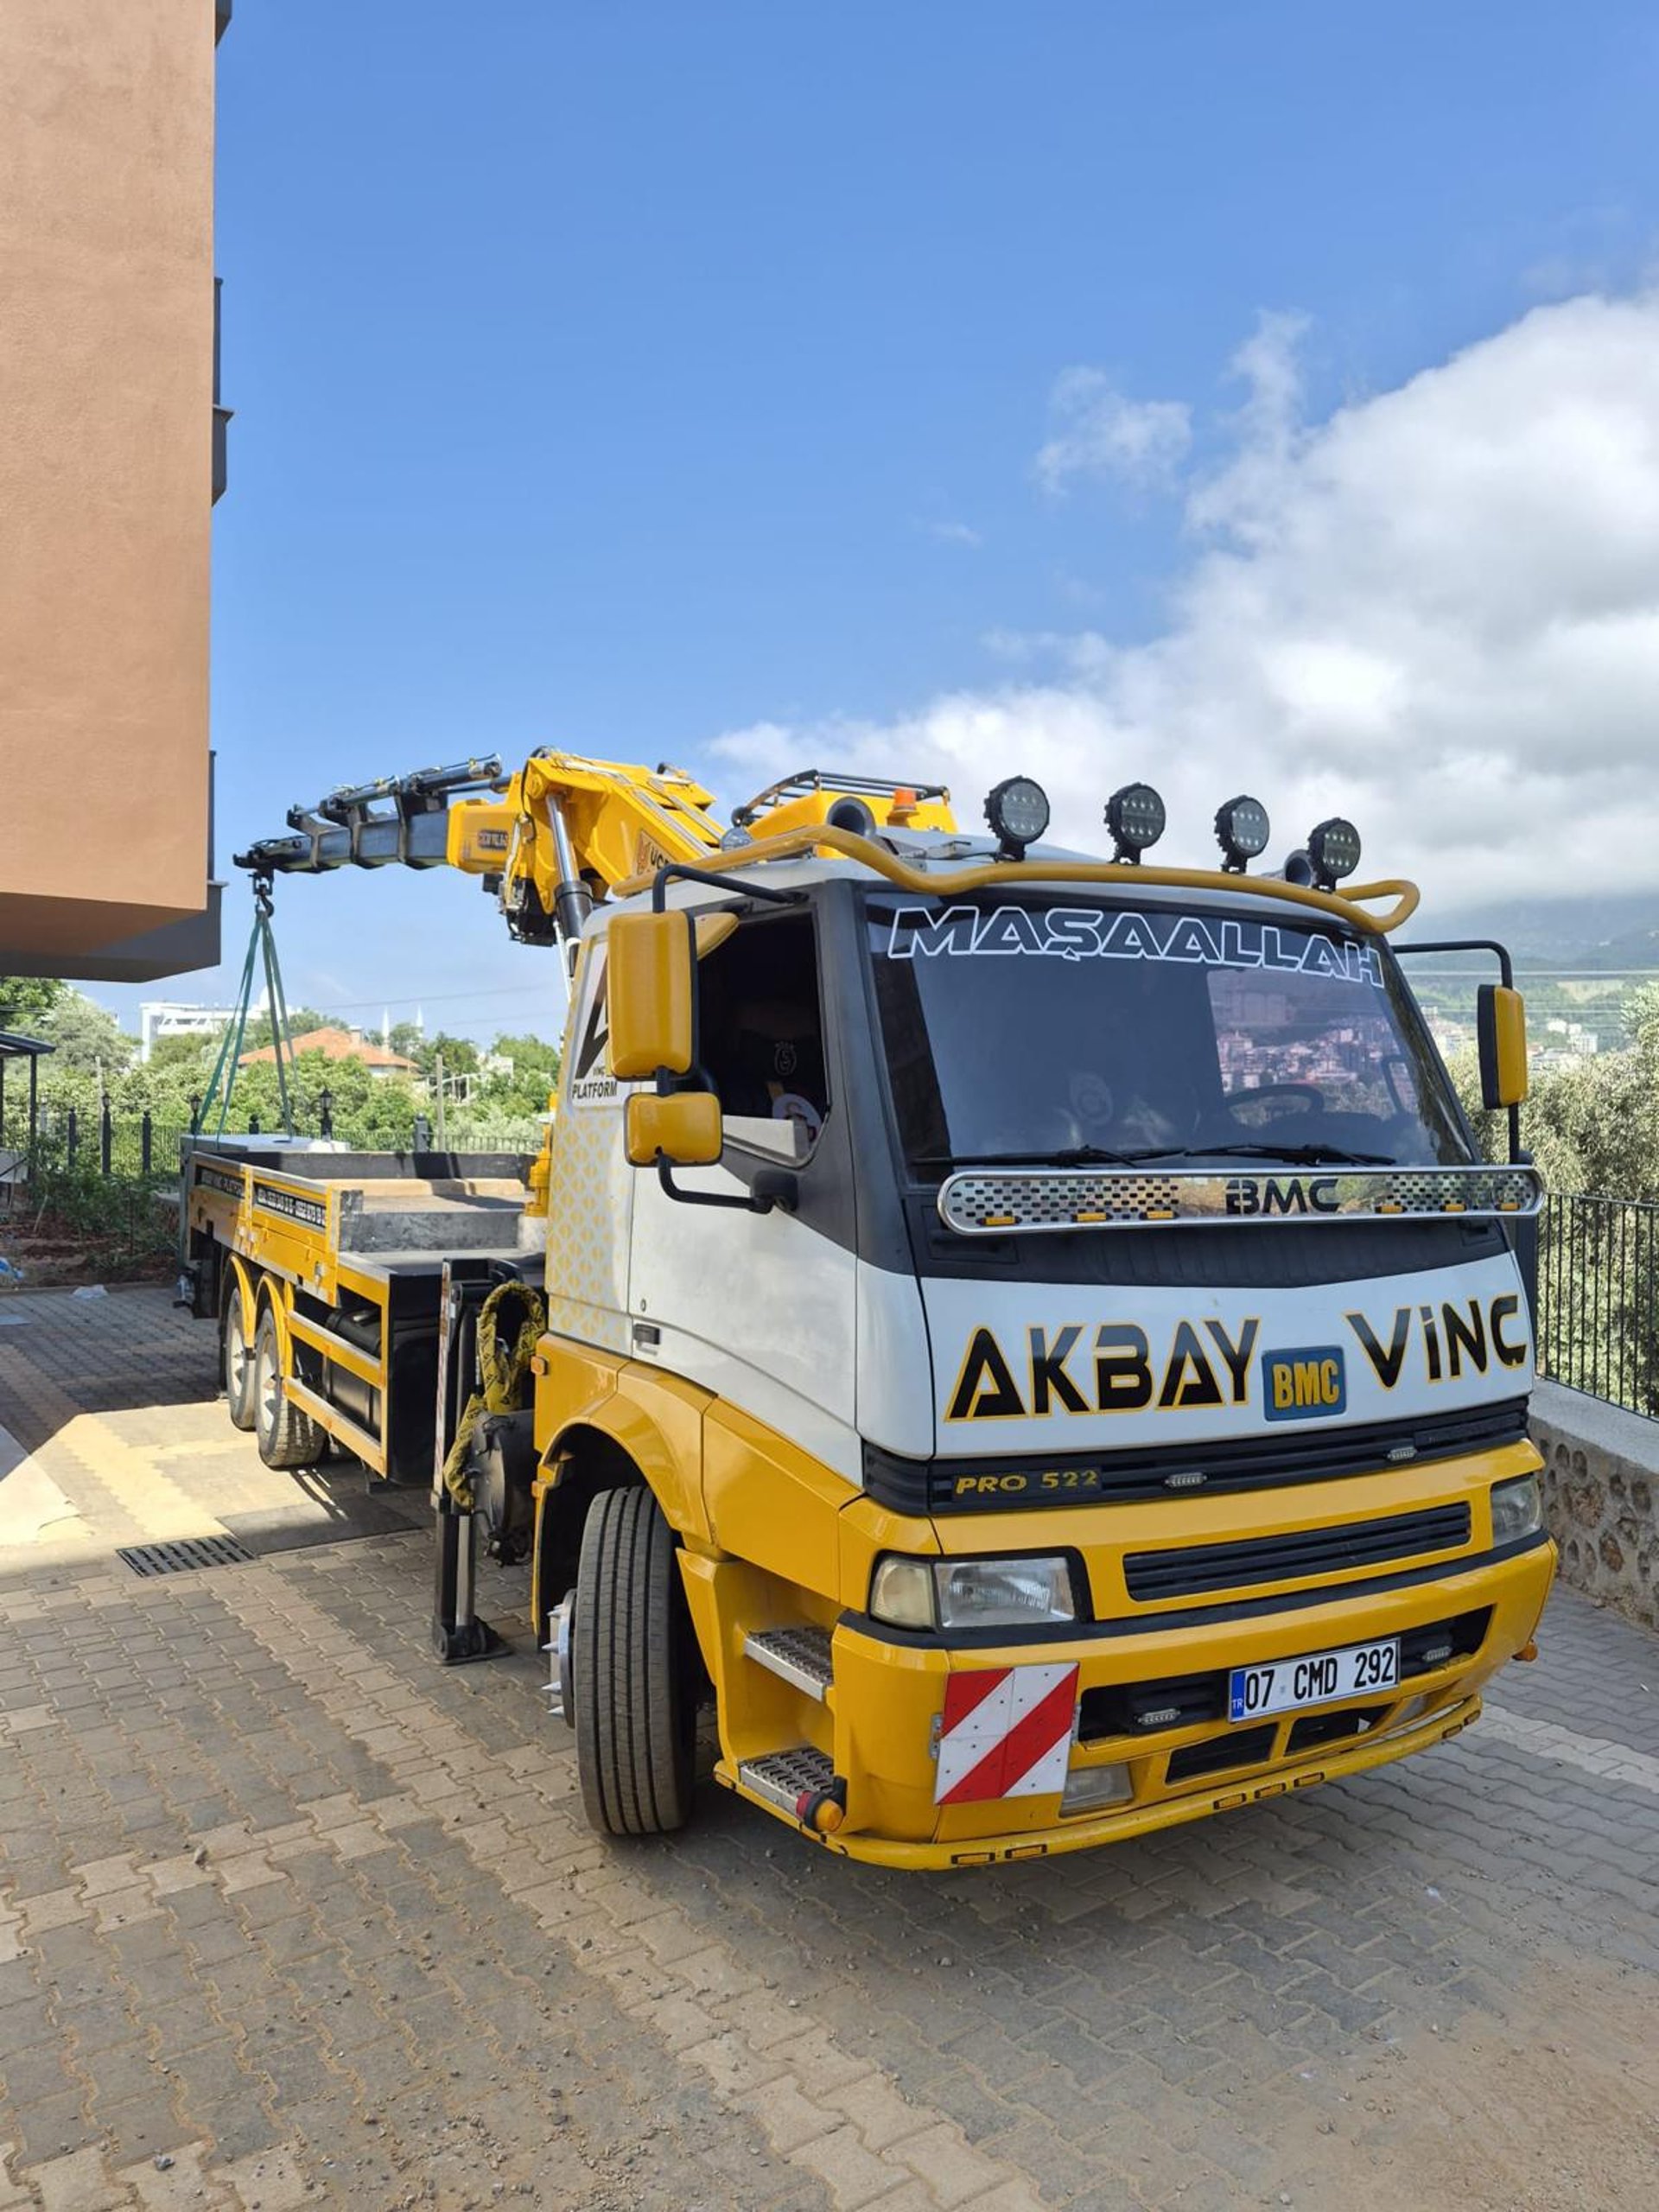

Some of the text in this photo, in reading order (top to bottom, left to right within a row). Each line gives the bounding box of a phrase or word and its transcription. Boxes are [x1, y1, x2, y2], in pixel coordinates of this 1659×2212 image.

[887, 905, 1385, 988] MAŞAALLAH
[571, 1080, 619, 1100] PLATFORM
[1225, 1178, 1341, 1215] BMC
[943, 1314, 1262, 1422] AKBAY
[1272, 1357, 1340, 1410] BMC
[956, 1470, 1098, 1495] PRO 522
[1245, 1645, 1395, 1711] 07 CMD 292
[1231, 1697, 1244, 1710] TR
